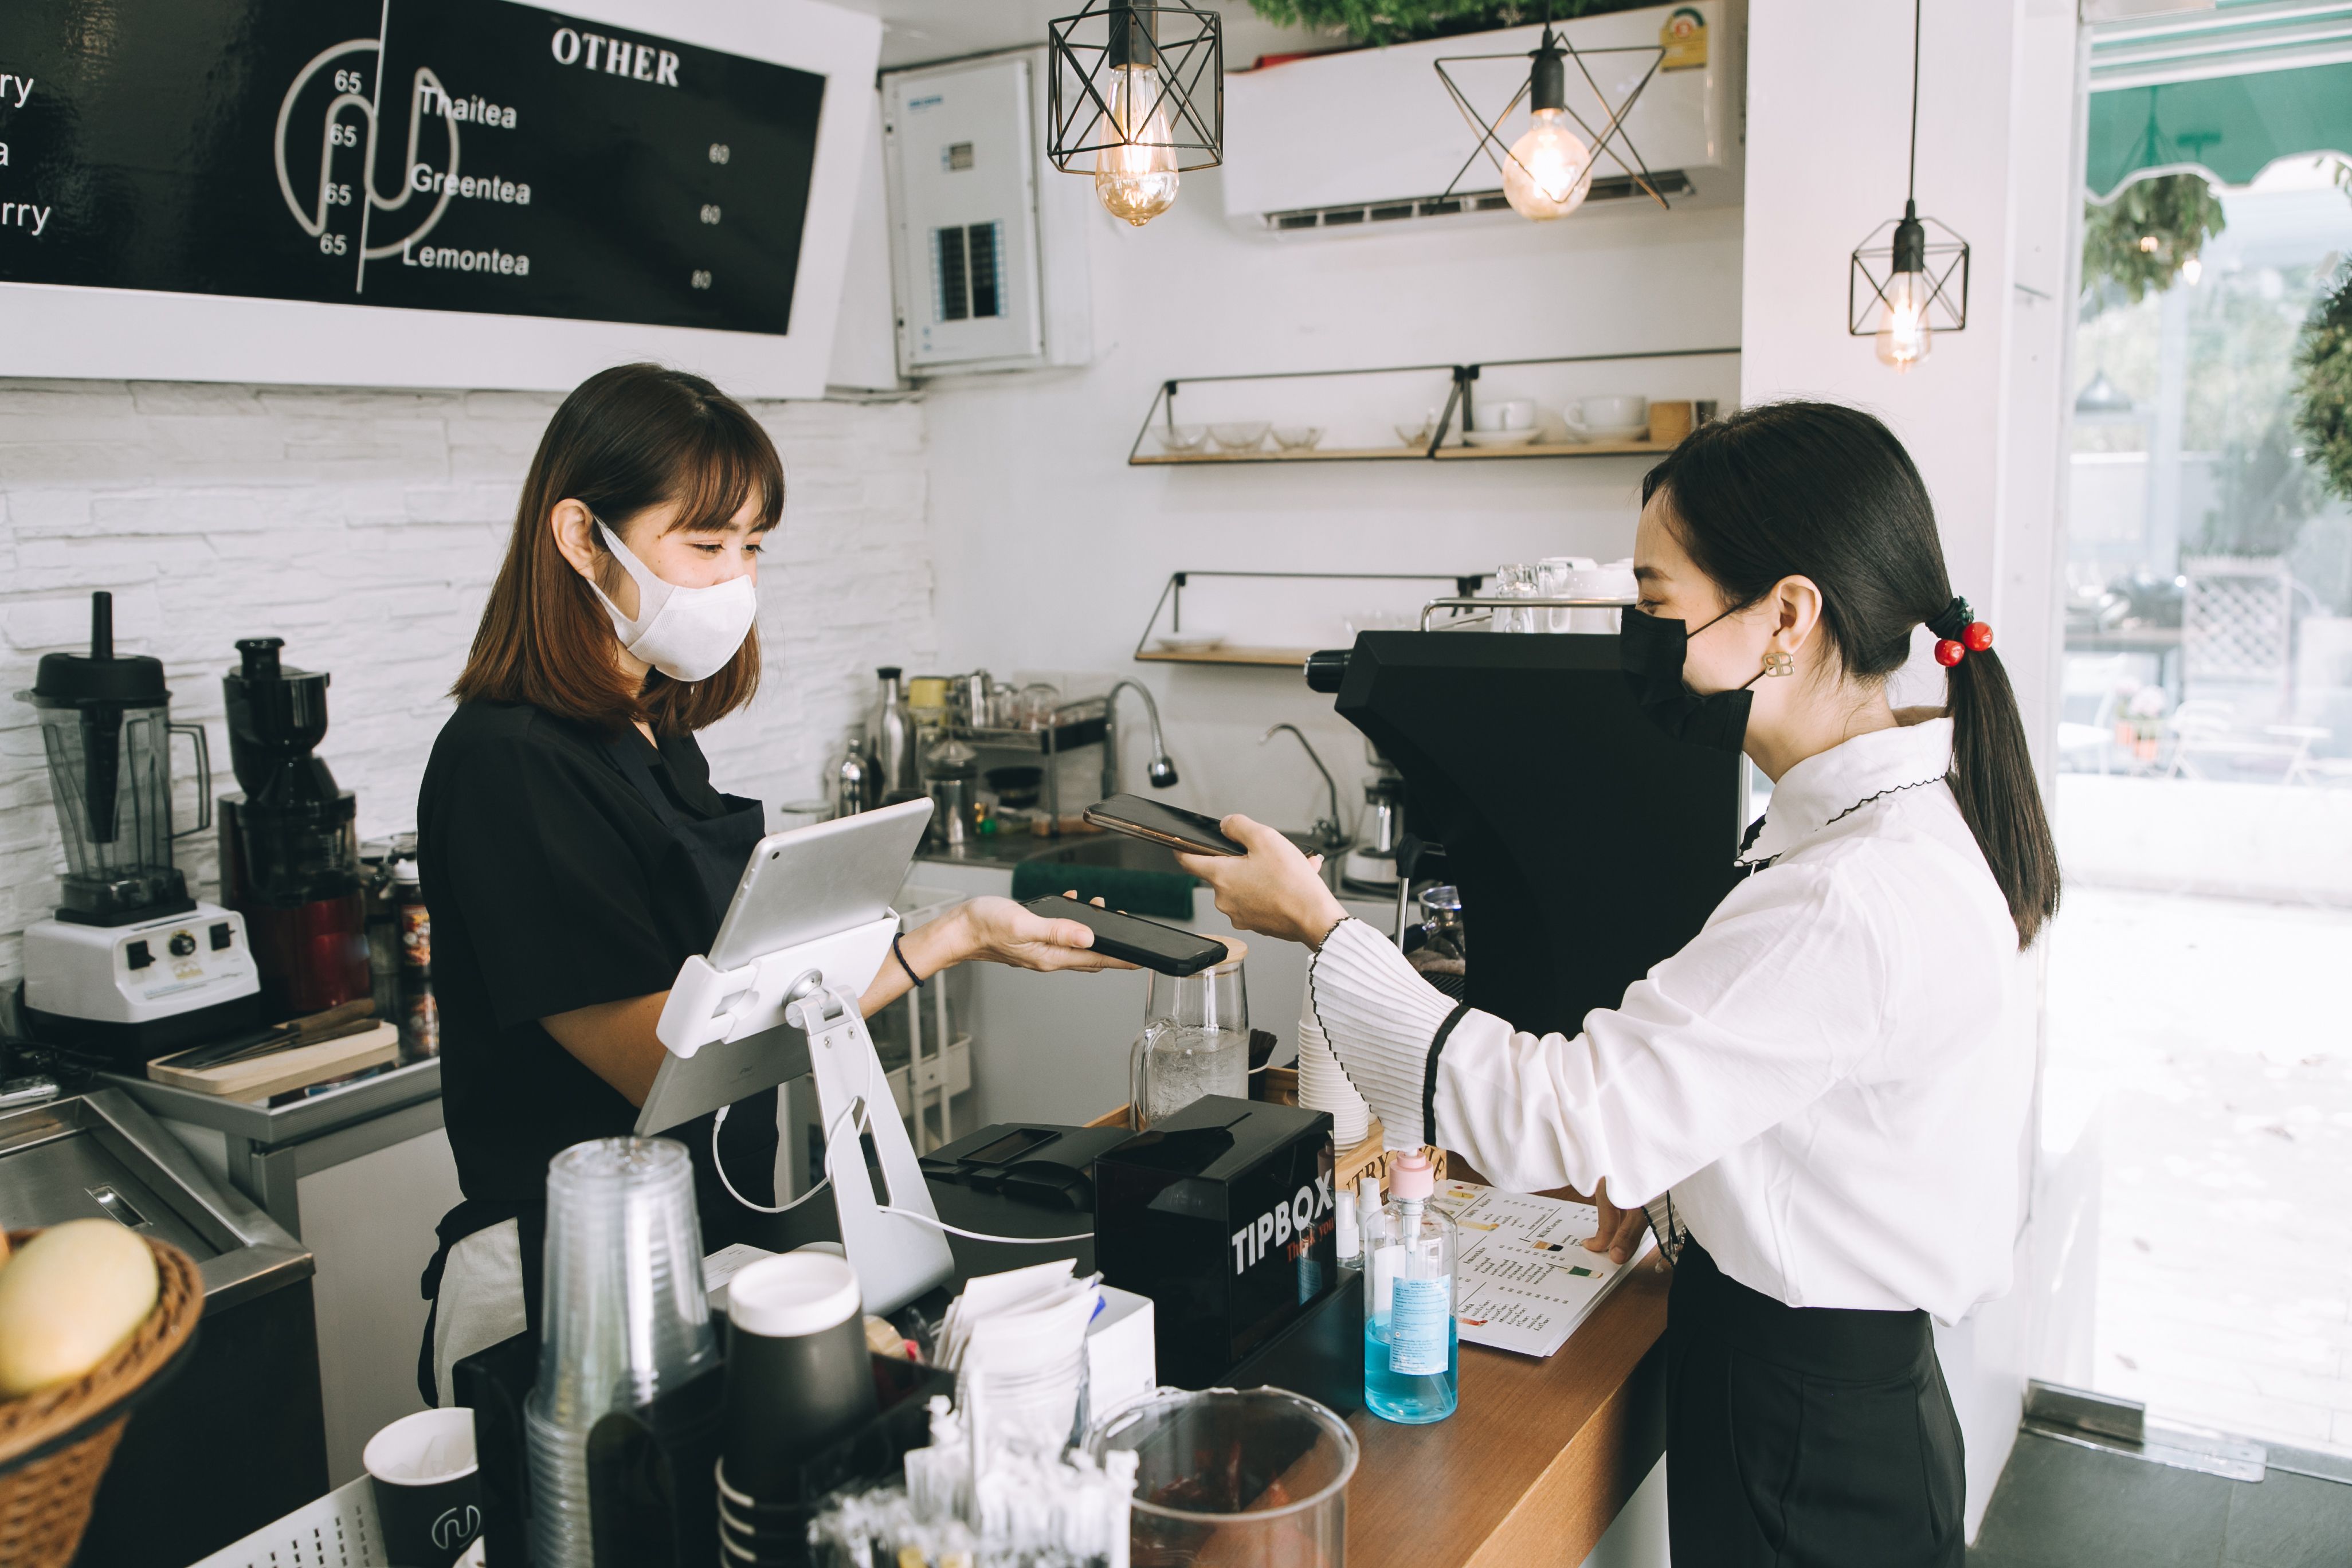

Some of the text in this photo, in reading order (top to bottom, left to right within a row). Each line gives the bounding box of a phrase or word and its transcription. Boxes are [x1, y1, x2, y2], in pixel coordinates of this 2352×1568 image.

[551, 28, 680, 88] OTHER
[335, 69, 362, 95] 65
[419, 85, 517, 129] Thaitea
[330, 123, 358, 148] 65
[324, 182, 352, 206] 65
[410, 163, 531, 205] Greentea
[2, 202, 52, 236] rry
[320, 233, 347, 256] 65
[402, 237, 530, 276] Lemontea
[1346, 1151, 1389, 1198] TRY
[1232, 1168, 1334, 1275] TIPBOX
[1318, 1217, 1335, 1242] you
[1463, 1247, 1487, 1264] Smoothie
[1459, 1303, 1475, 1314] Soda
